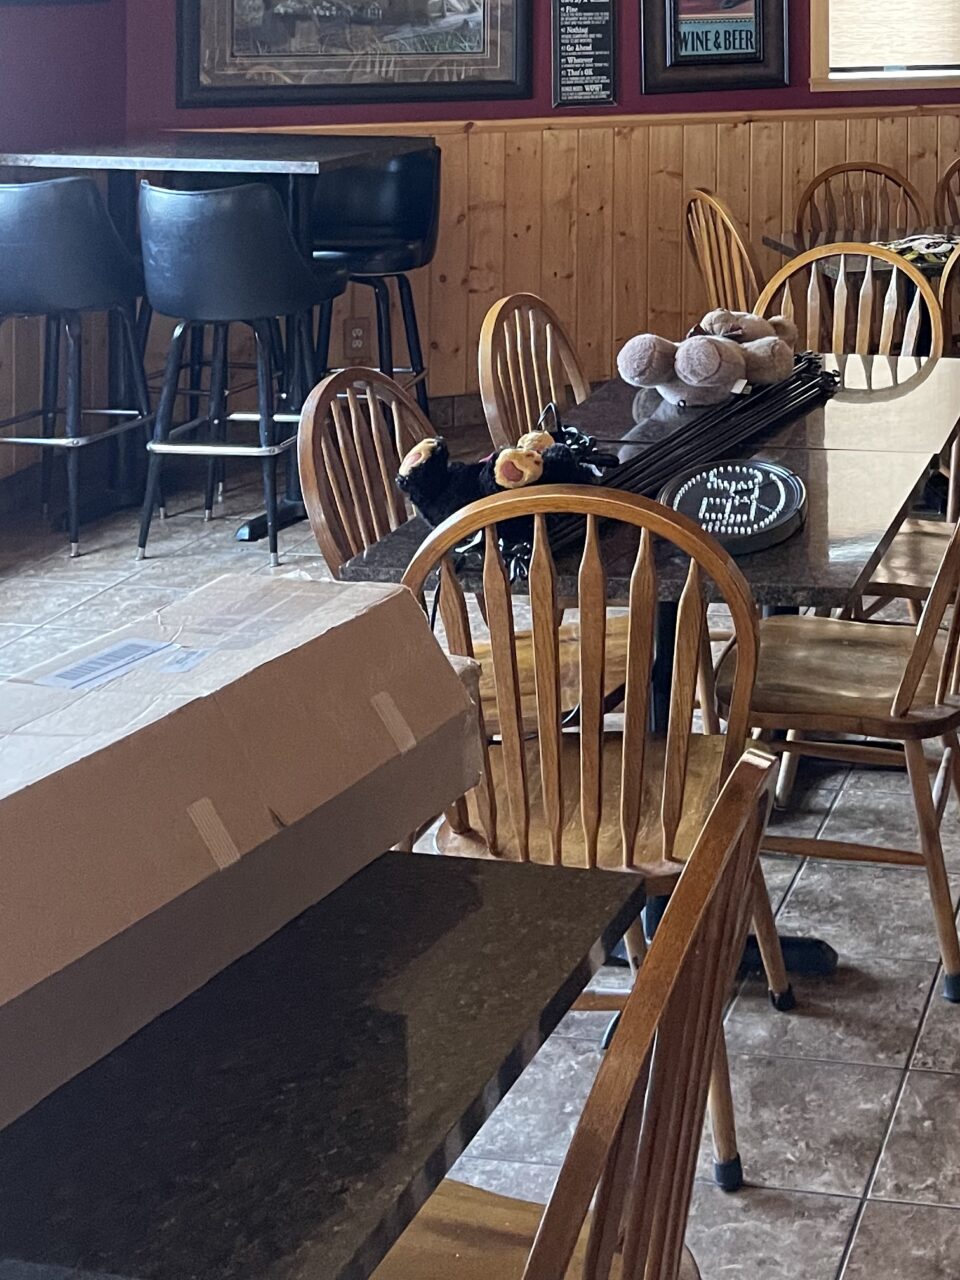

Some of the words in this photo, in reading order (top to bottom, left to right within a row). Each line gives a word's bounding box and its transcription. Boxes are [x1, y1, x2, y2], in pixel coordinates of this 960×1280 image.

[566, 44, 575, 52] Go
[679, 30, 712, 52] WINE
[713, 30, 722, 51] &
[724, 29, 754, 51] BEER
